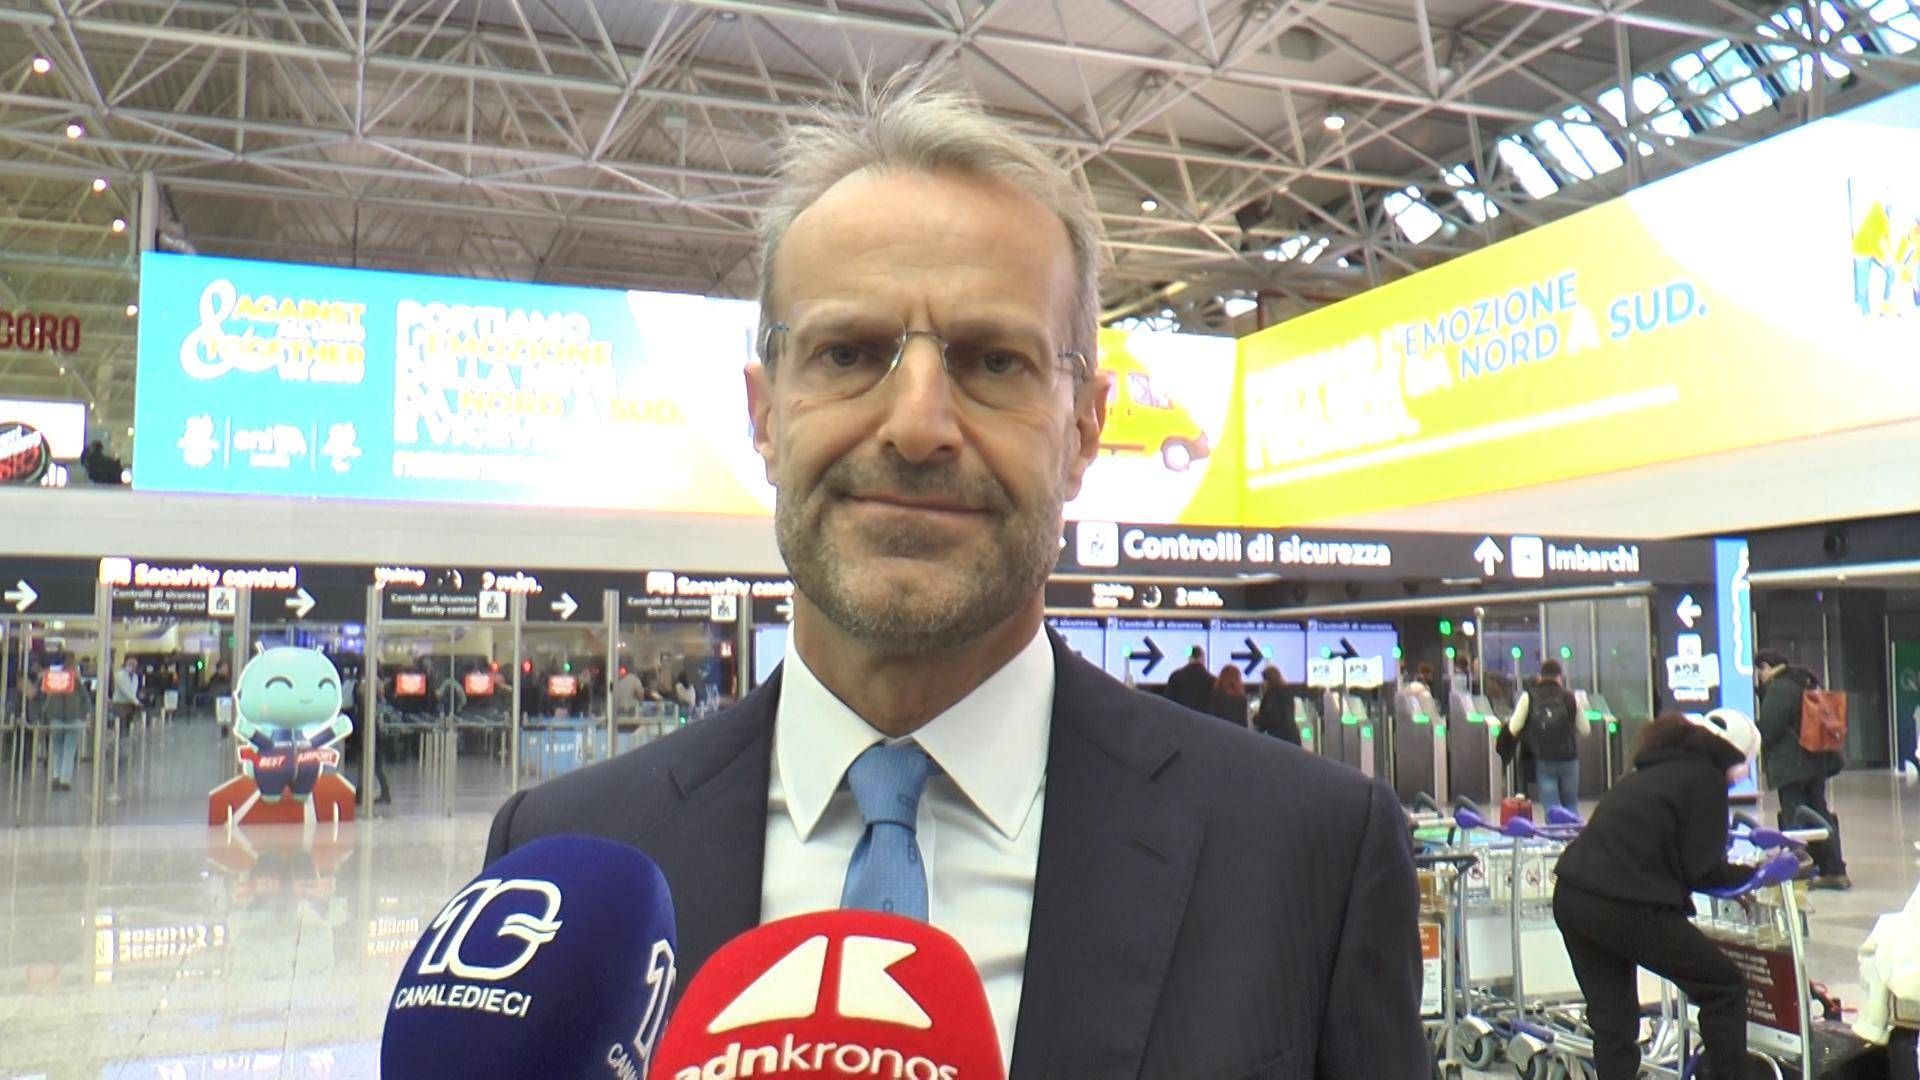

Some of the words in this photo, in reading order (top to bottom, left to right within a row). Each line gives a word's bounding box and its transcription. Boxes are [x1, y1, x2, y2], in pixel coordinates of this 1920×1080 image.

[1460, 322, 1558, 379] NORD
[1610, 282, 1707, 340] SUD.
[1123, 529, 1241, 562] Controlli
[1247, 532, 1274, 562] di
[1278, 534, 1391, 566] sicurezza
[1548, 543, 1639, 572] Imbarchi
[135, 563, 220, 588] Security
[222, 566, 297, 589] control
[752, 580, 795, 597] cont
[259, 755, 286, 768] BEST
[297, 750, 334, 762] AIRPORT
[395, 984, 532, 1018] CANALEDIECI
